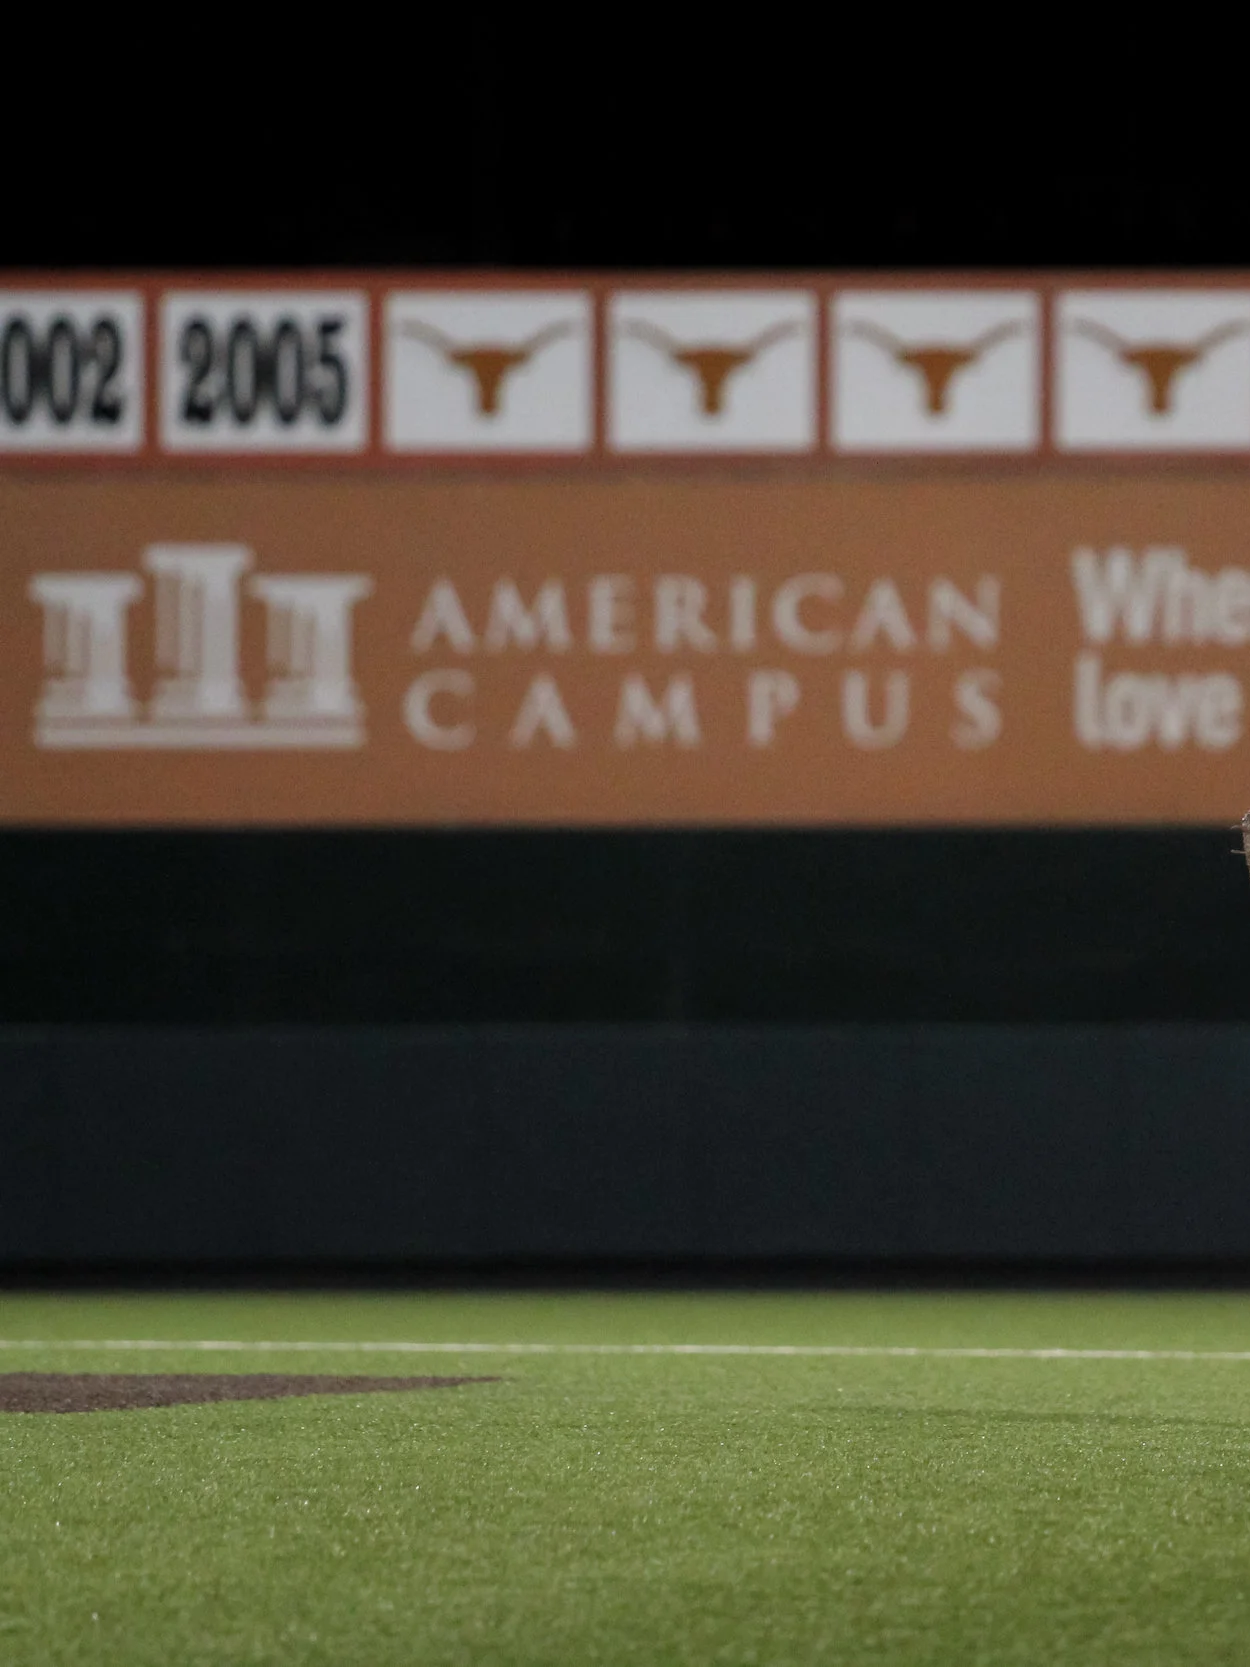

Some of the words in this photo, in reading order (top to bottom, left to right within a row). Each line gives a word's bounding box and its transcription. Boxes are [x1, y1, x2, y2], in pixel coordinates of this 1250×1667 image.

[0, 315, 121, 425] 002
[182, 315, 347, 425] 2005
[409, 574, 1001, 654] AMERICAN
[403, 669, 1002, 750] CAMPUS
